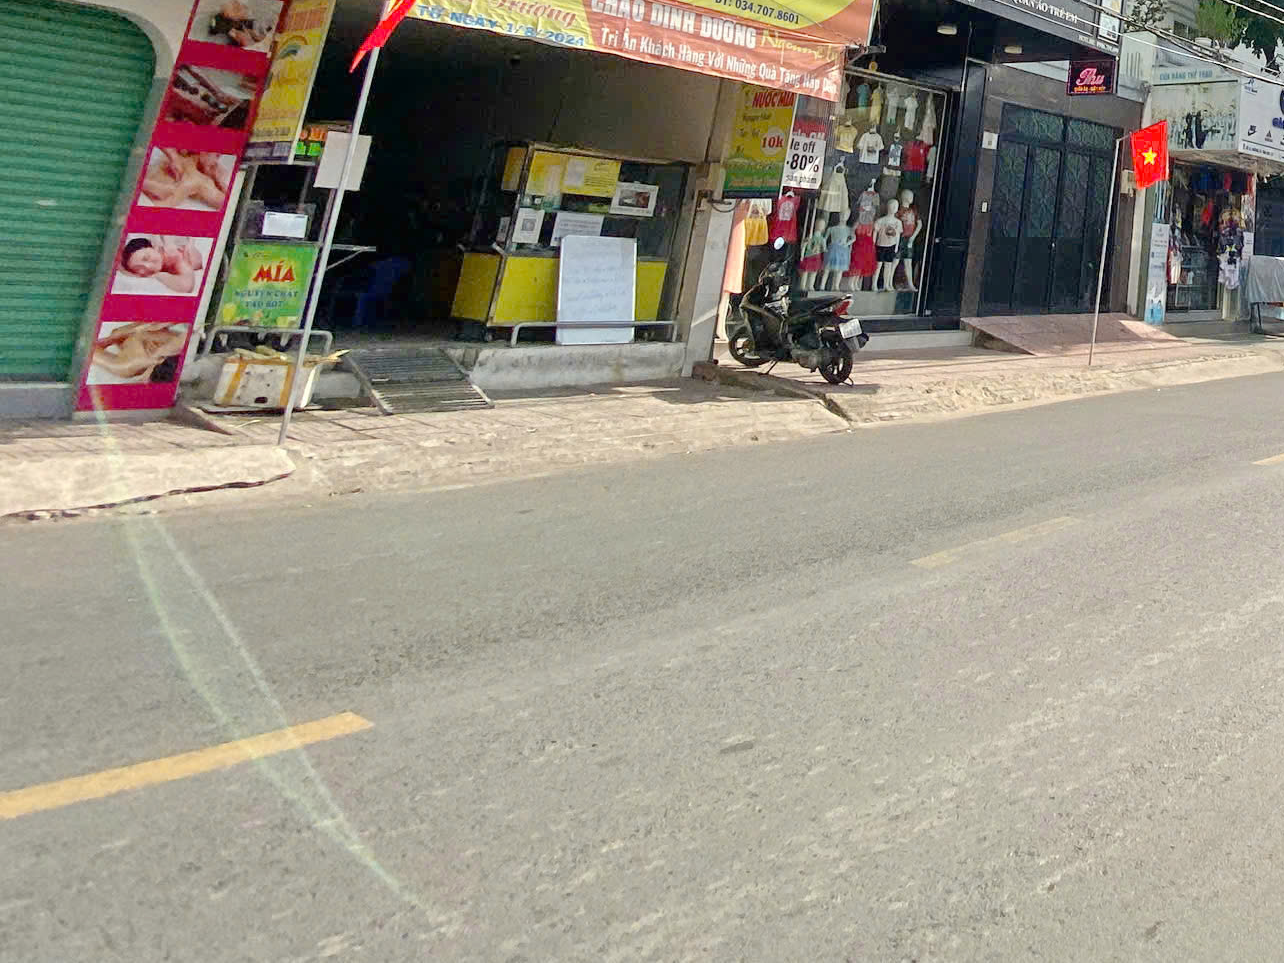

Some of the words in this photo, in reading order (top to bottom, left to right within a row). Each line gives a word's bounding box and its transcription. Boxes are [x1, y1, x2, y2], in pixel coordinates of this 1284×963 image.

[650, 1, 697, 35] DINH
[639, 35, 675, 59] Khách
[679, 43, 705, 67] Hàng
[727, 55, 757, 80] Những
[759, 63, 777, 81] Quà
[1075, 67, 1105, 86] Thu
[802, 141, 816, 154] off
[251, 258, 296, 284] MÍA
